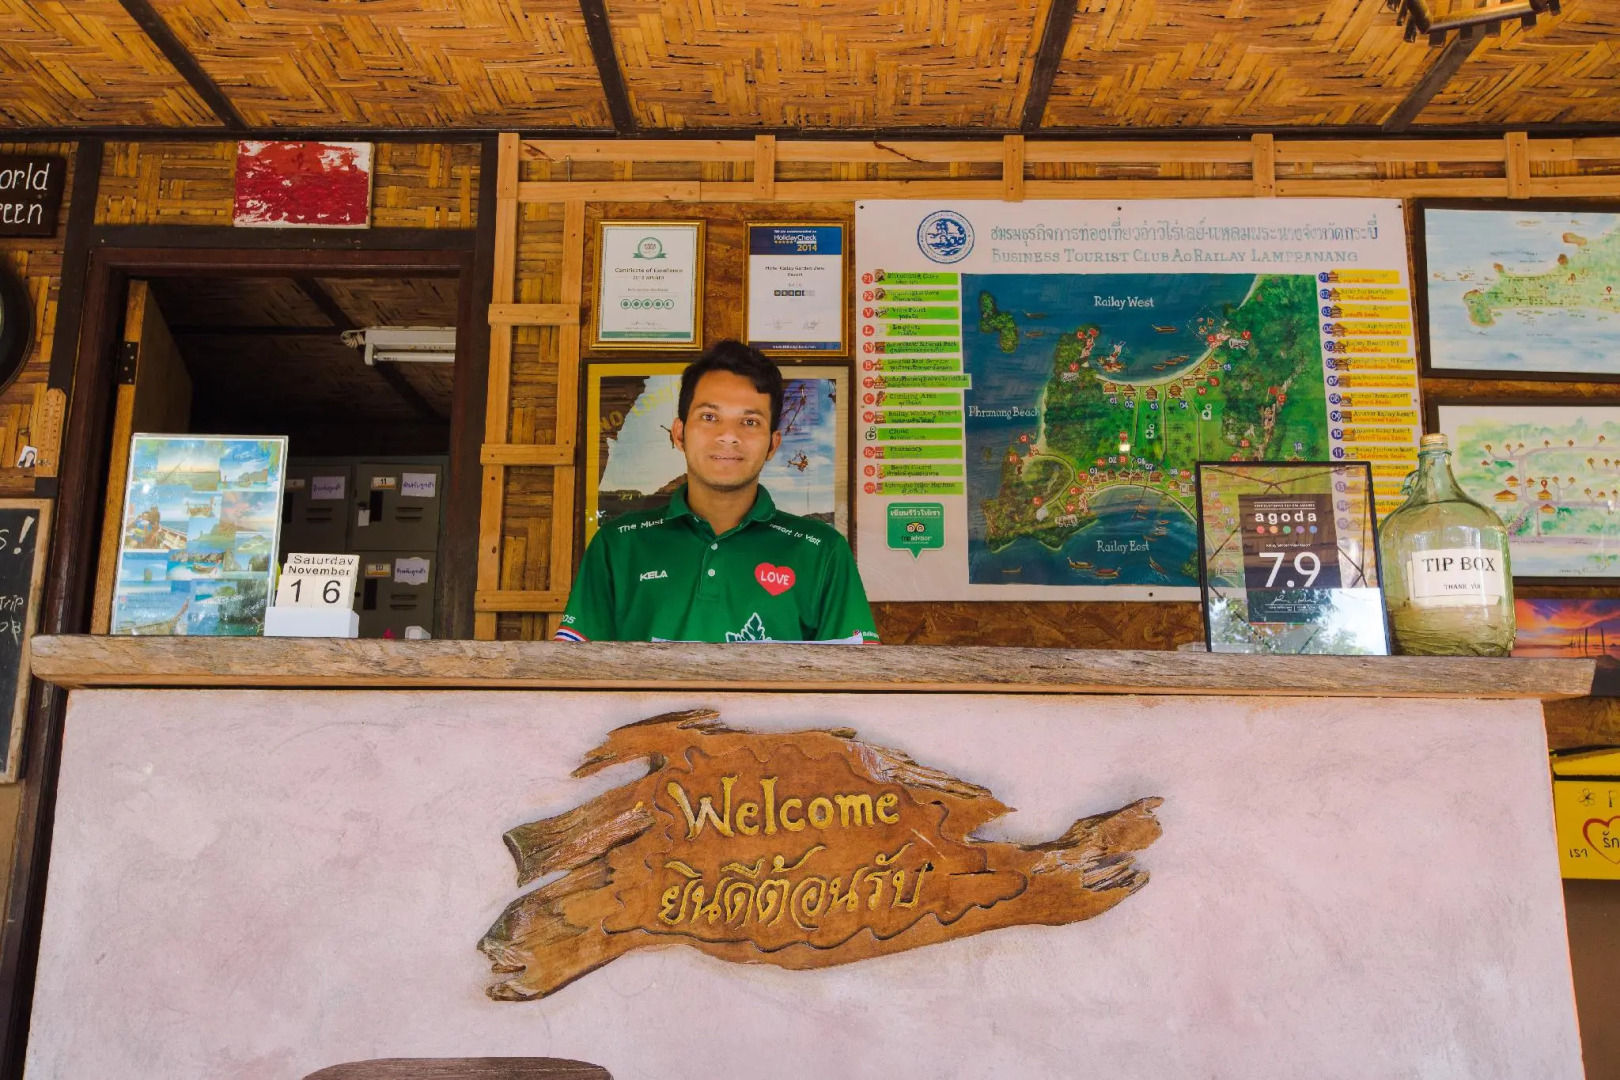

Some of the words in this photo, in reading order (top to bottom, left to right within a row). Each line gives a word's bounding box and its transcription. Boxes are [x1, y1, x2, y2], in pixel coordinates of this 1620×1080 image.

[0, 203, 43, 225] een
[773, 234, 817, 243] HolidayCheck
[797, 244, 818, 252] 2014
[992, 249, 1060, 263] BUSINESS
[1064, 249, 1130, 263] TOURIST
[1133, 249, 1170, 262] CLUB
[1194, 249, 1246, 262] RAILAY
[1094, 295, 1125, 310] Railay
[1127, 295, 1155, 307] West
[1124, 400, 1134, 408] 02
[1179, 401, 1188, 409] 04
[968, 405, 1012, 419] Phranang
[1013, 406, 1040, 417] Beach
[1254, 510, 1317, 525] agoda
[618, 523, 637, 534] The
[1096, 540, 1128, 554] Railay
[1129, 540, 1150, 551] East
[293, 554, 354, 565] Saturday
[1421, 557, 1454, 572] TIP
[1459, 556, 1497, 573] BOX
[288, 565, 351, 576] November
[640, 569, 669, 581] KELA
[1259, 551, 1321, 588] 7.9
[760, 570, 791, 586] LOVE
[667, 774, 899, 840] Welcome
[1569, 848, 1588, 858] เรา
[658, 842, 934, 931] ยินดีต้อนรับ
